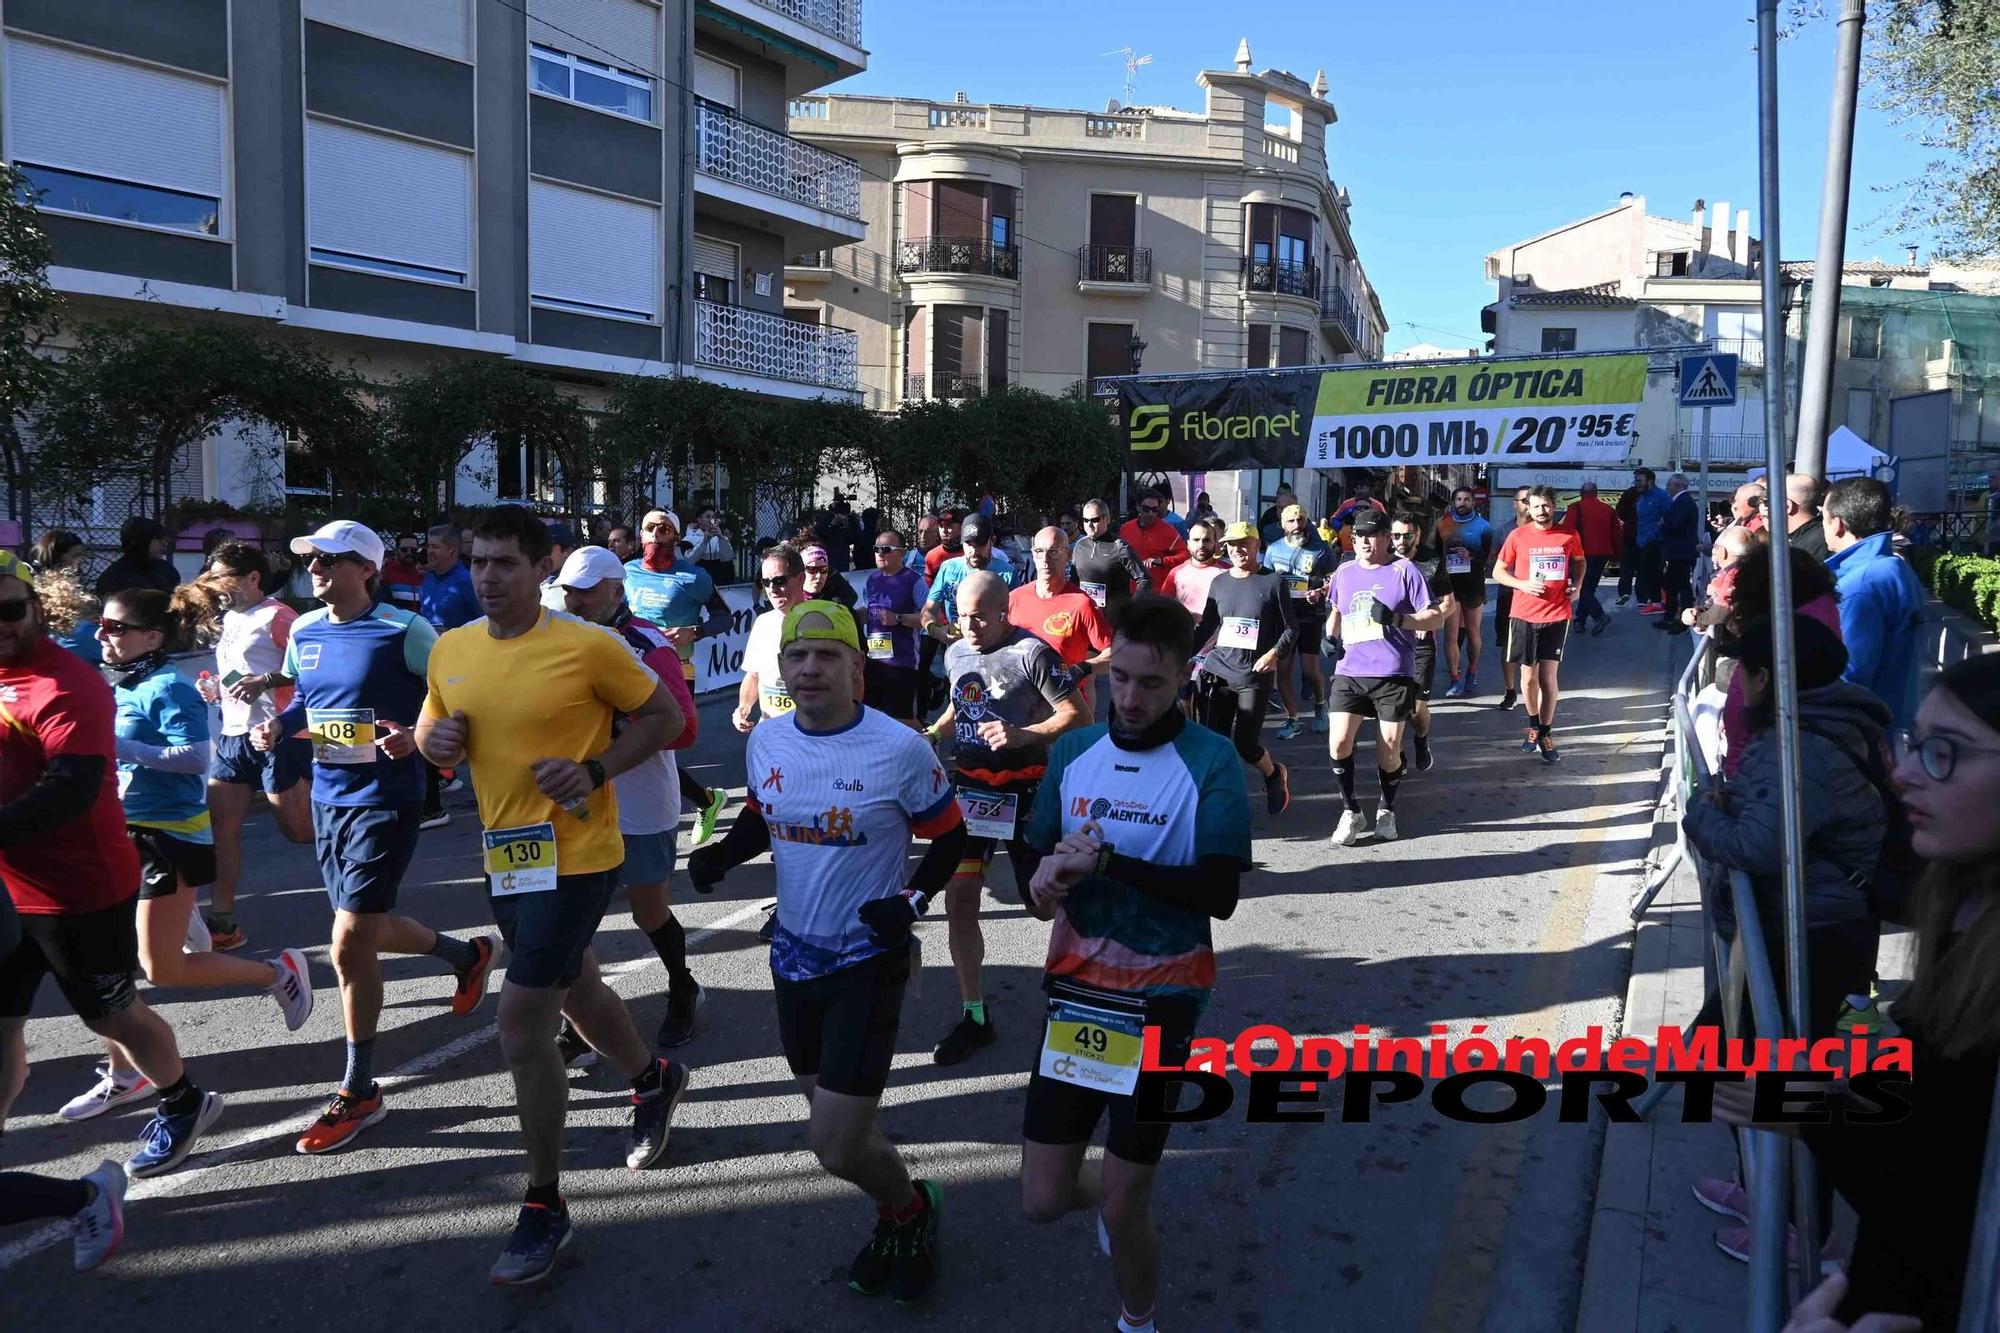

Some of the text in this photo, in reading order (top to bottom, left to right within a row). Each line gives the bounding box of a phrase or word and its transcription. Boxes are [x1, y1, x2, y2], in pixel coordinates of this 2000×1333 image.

[1366, 366, 1584, 407] FIBRA ÓPTICA
[1180, 410, 1300, 441] fibranet
[1318, 431, 1328, 460] HASTA
[1329, 423, 1419, 460] 1000
[1427, 420, 1489, 457] Mb
[1538, 561, 1558, 570] 810
[1229, 624, 1249, 635] 03
[768, 695, 792, 708] 136
[319, 723, 356, 739] 108
[1108, 808, 1169, 826] MENTIRAS
[503, 841, 541, 863] 130
[1074, 1026, 1108, 1052] 49
